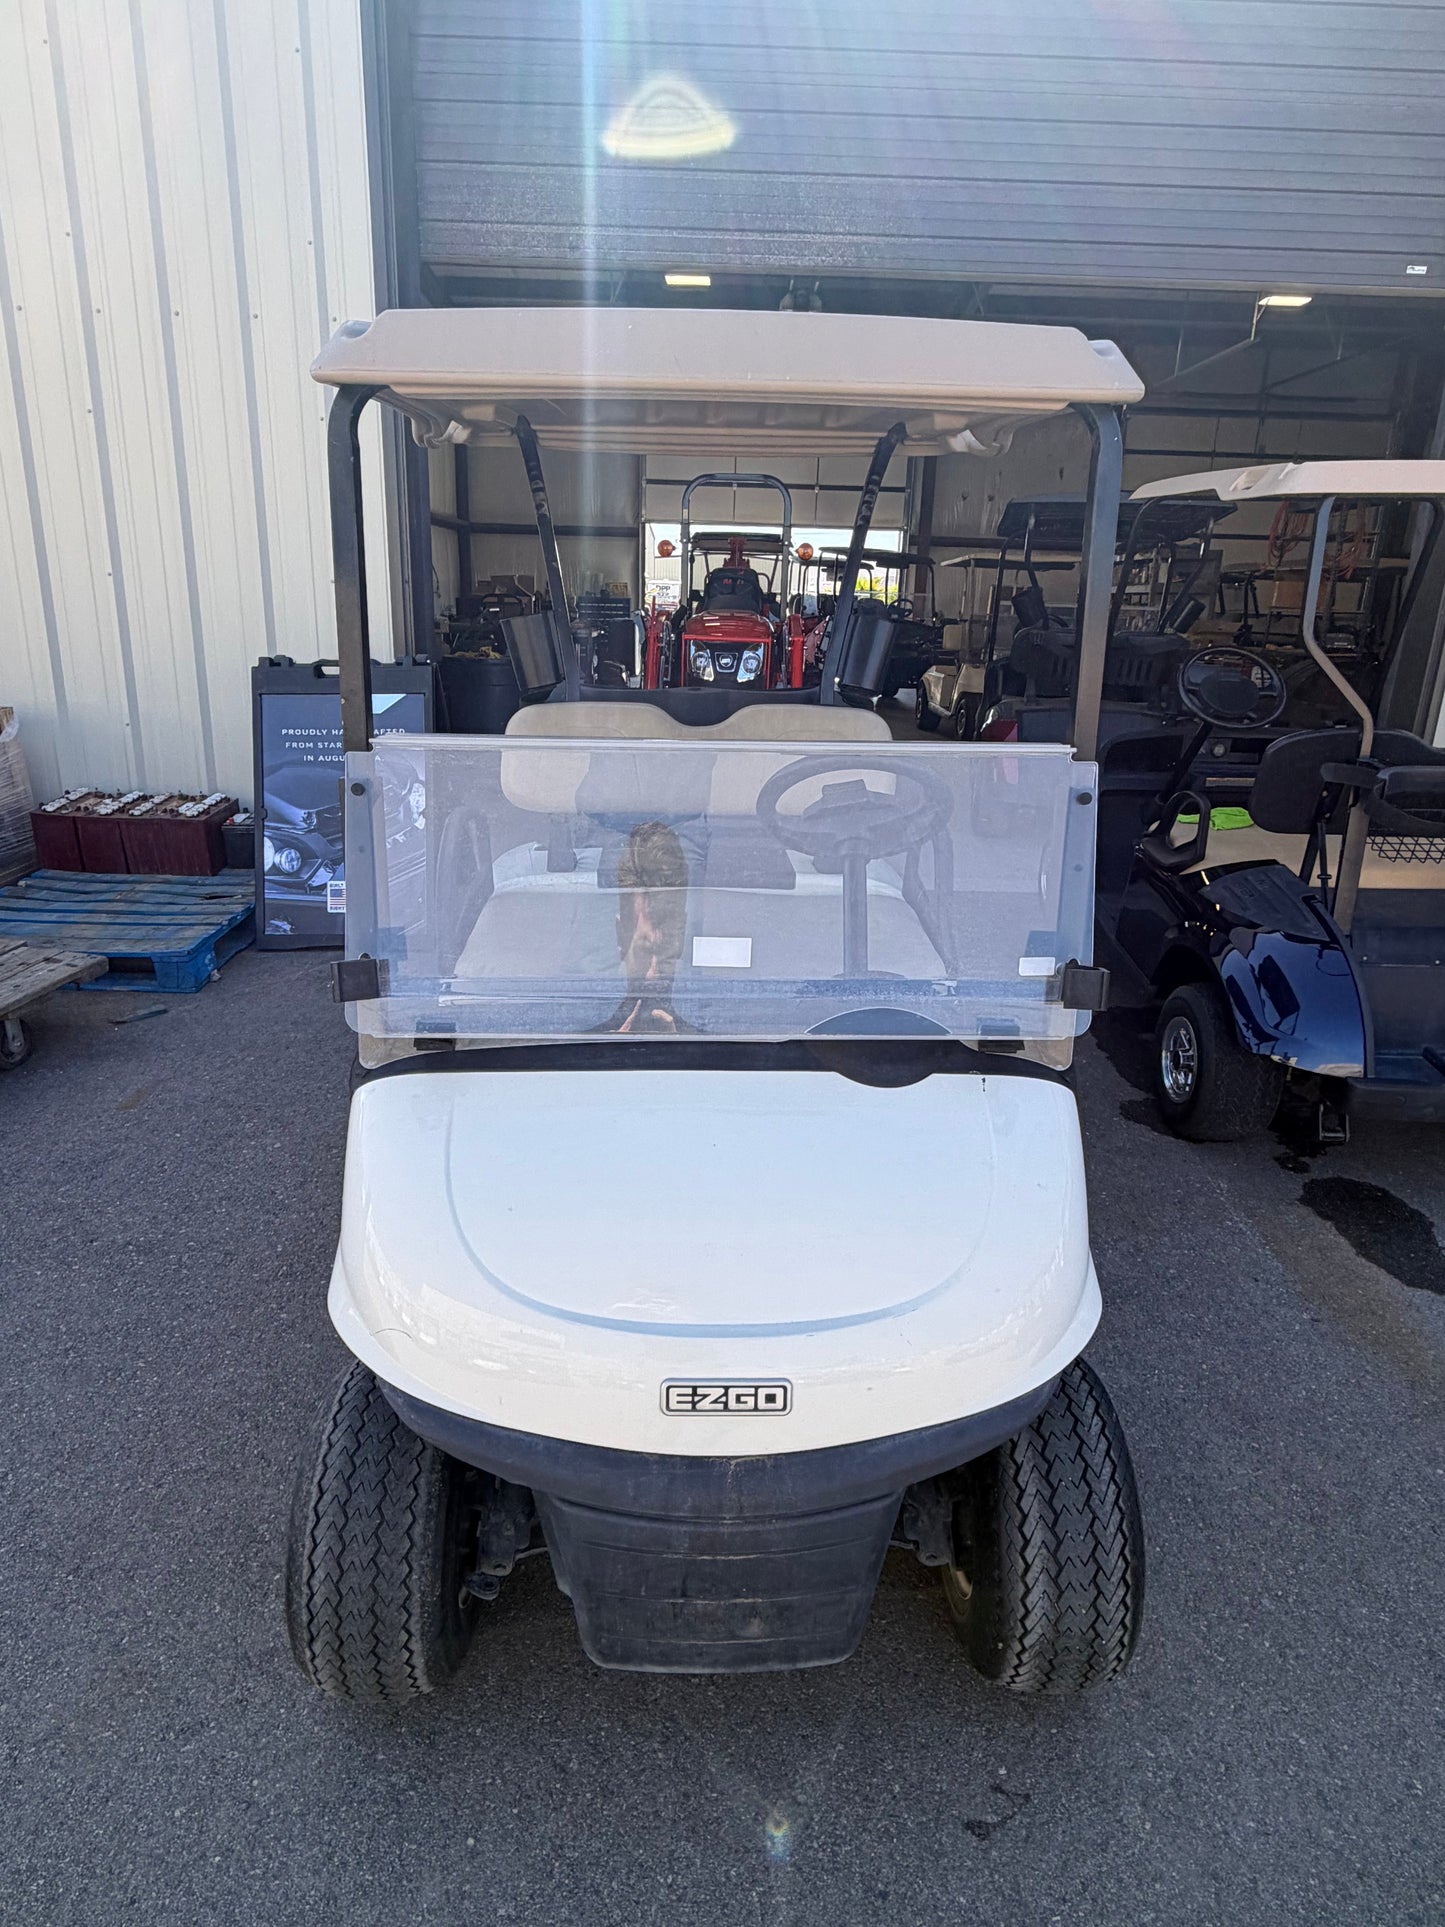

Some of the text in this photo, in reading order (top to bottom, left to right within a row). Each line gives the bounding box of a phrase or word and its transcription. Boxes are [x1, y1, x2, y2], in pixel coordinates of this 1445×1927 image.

[281, 728, 405, 736] PROUDLY HAAFTED
[285, 741, 343, 749] FROM STAR
[668, 1386, 785, 1411] EZGO
